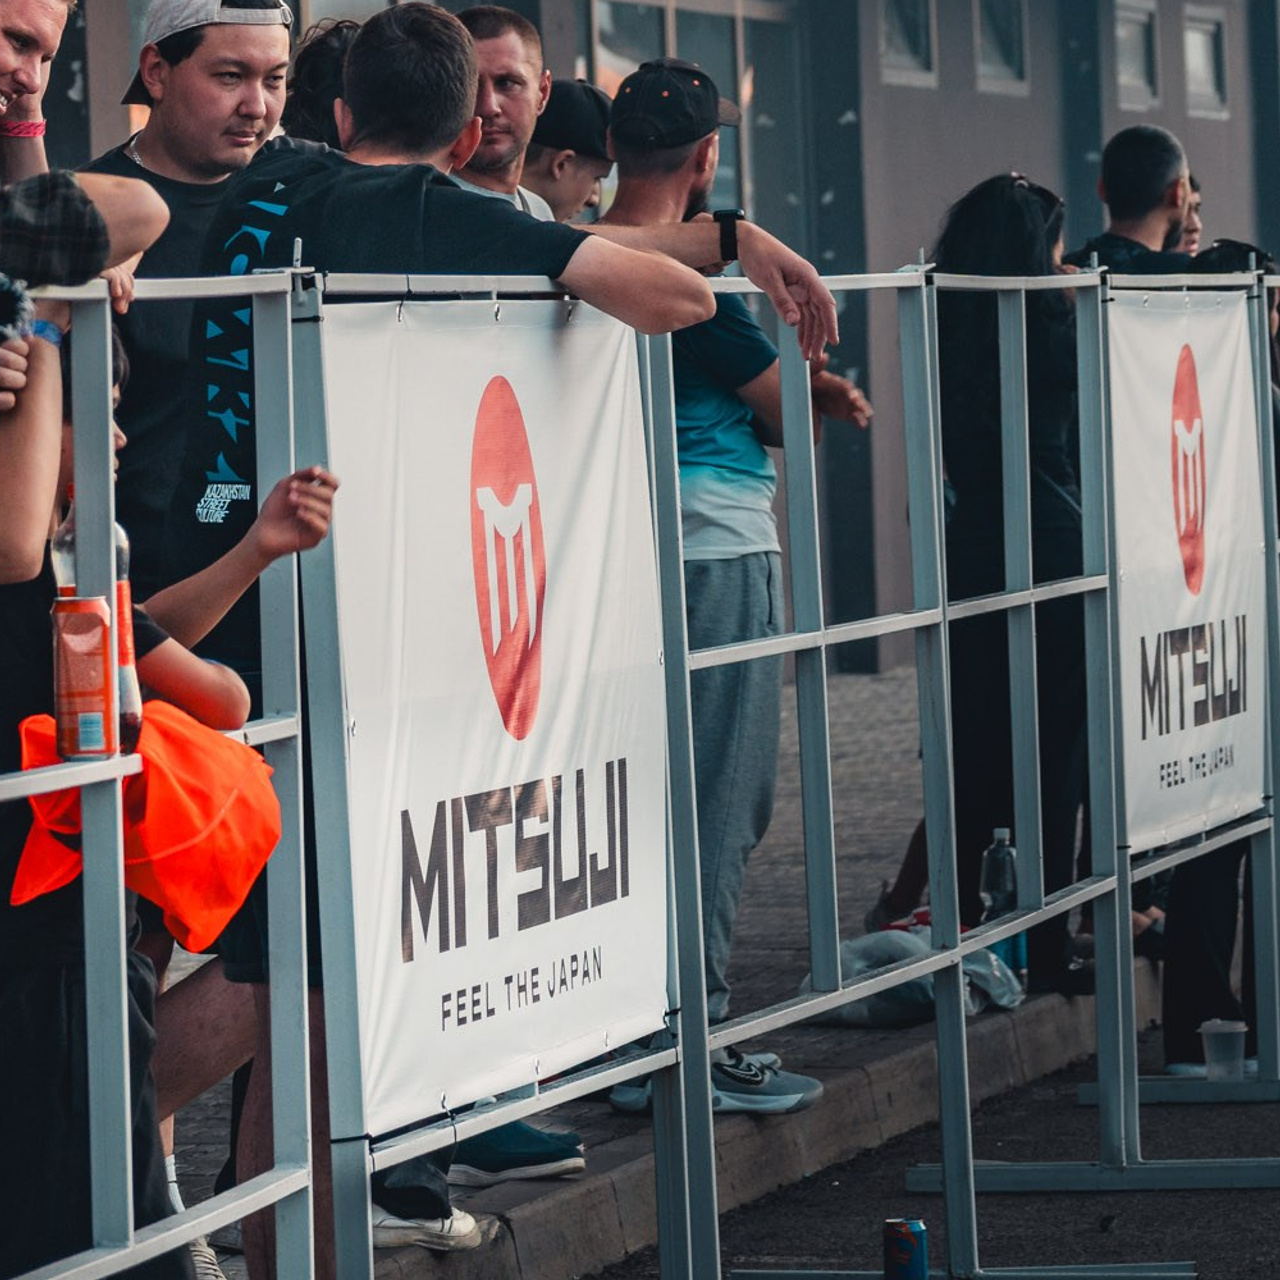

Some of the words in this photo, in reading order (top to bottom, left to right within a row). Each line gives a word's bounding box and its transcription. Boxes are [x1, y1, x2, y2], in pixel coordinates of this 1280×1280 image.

[195, 508, 230, 523] CULTURE
[197, 497, 231, 510] STREET
[204, 483, 251, 500] KAZAKHSTAN
[1140, 614, 1247, 741] MITSUJI
[1159, 752, 1185, 790] FEEL
[1188, 746, 1207, 781] THE
[1208, 739, 1235, 776] JAPAN
[400, 757, 630, 964] MITSUJI
[441, 981, 496, 1032] FEEL
[504, 967, 541, 1011] THE
[547, 945, 602, 999] JAPAN
